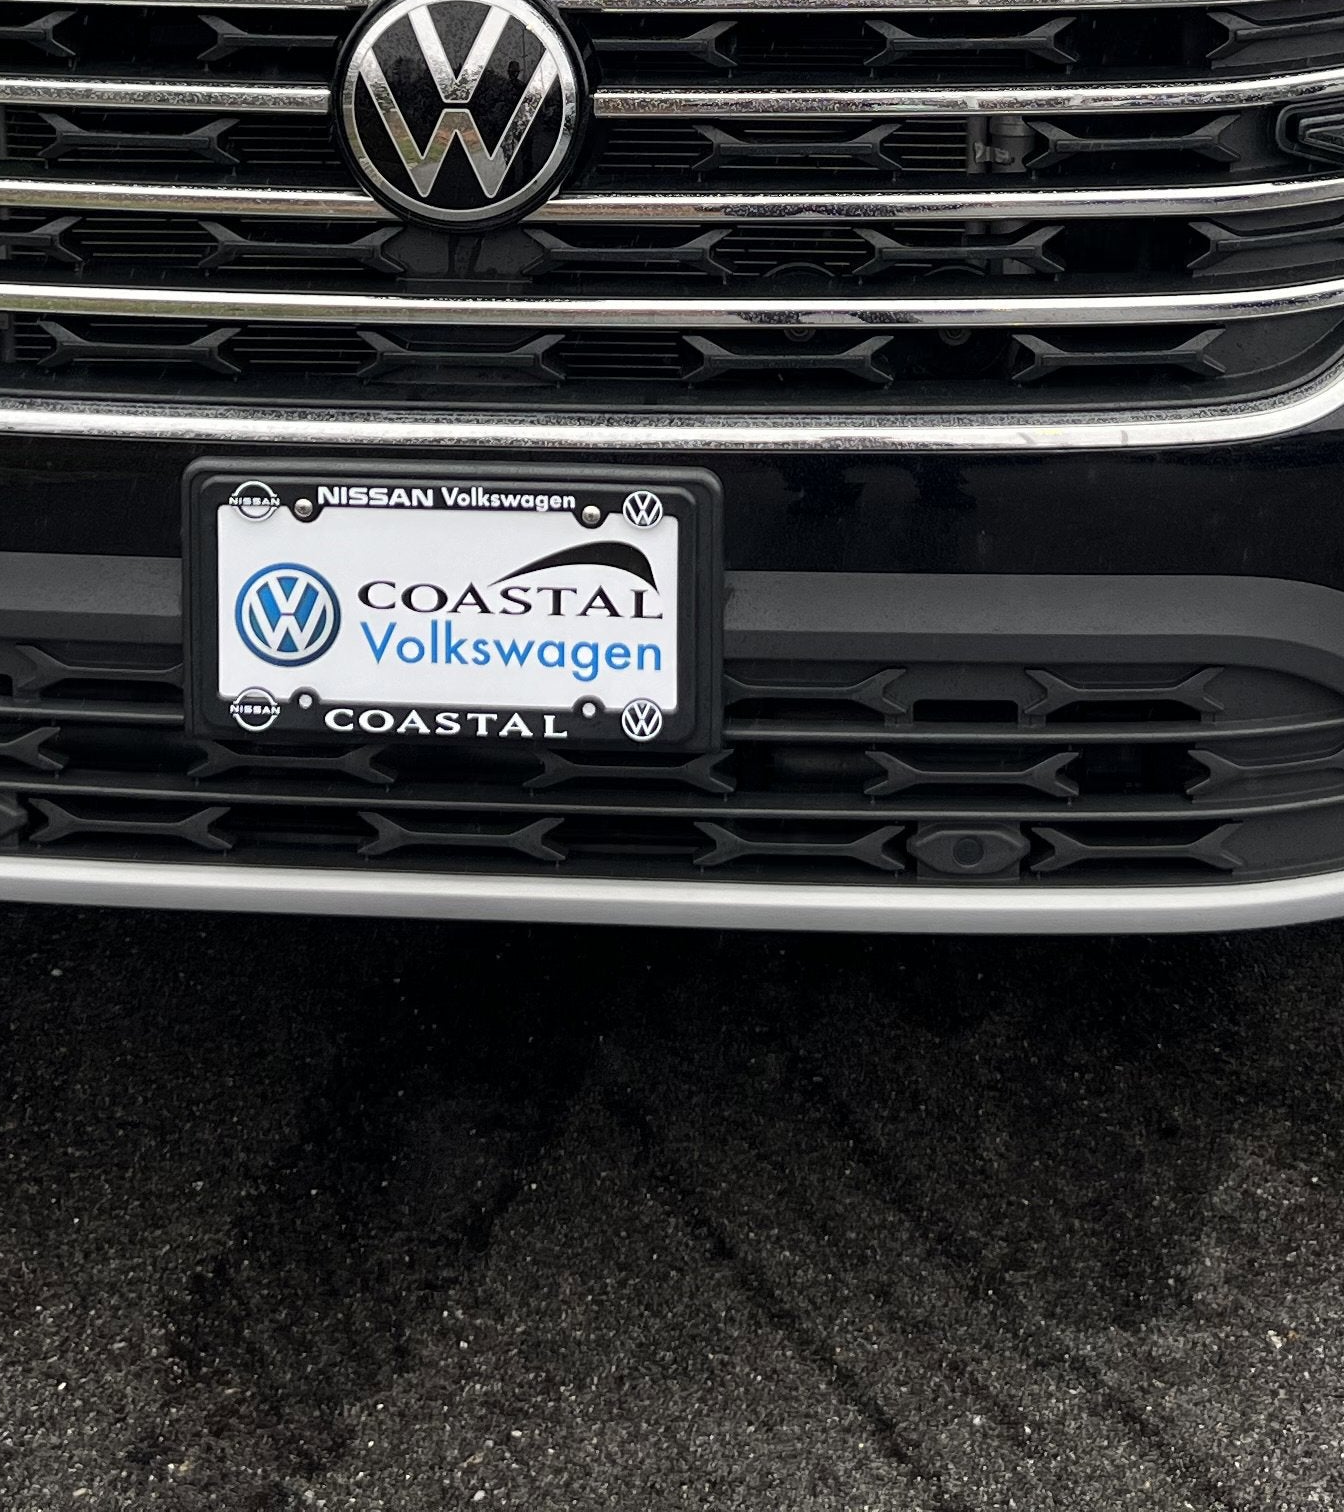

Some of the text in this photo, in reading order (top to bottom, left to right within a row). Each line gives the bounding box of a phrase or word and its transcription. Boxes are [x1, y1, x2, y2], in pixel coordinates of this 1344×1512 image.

[229, 496, 281, 506] NISSAN
[318, 487, 576, 512] NISSAN Volkswagen
[624, 491, 662, 528] VW
[240, 569, 337, 659] VW
[357, 580, 663, 619] COASTAL
[360, 620, 662, 682] Volkswagen
[230, 704, 281, 715] NISSAN
[324, 708, 568, 738] COASTAL
[623, 699, 662, 740] VW
